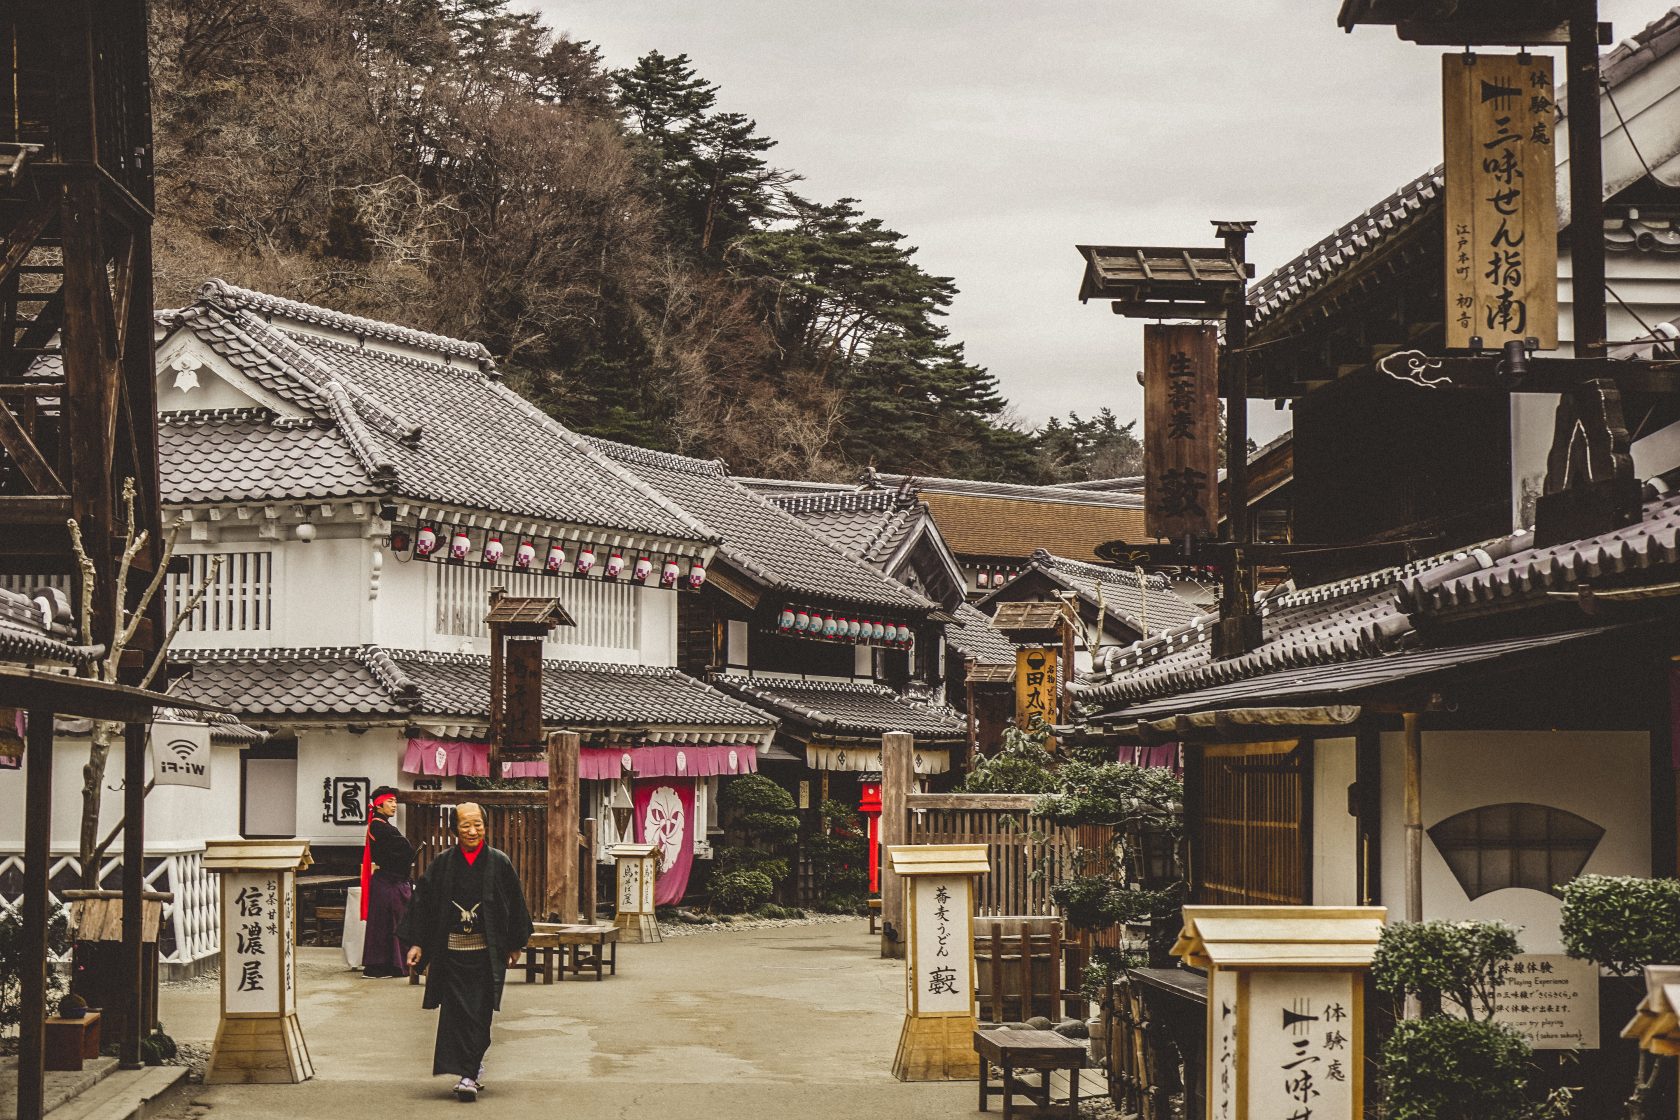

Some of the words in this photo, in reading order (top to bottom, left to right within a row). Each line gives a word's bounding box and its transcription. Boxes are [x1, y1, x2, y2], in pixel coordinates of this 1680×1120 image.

[1483, 116, 1526, 335] 三味せん指南
[235, 886, 266, 993] 信濃屋
[266, 880, 279, 936] お茶甘味
[934, 885, 952, 958] 蕎麦うどん
[1488, 961, 1554, 974] 味線体験
[1323, 1002, 1349, 1083] 体験處
